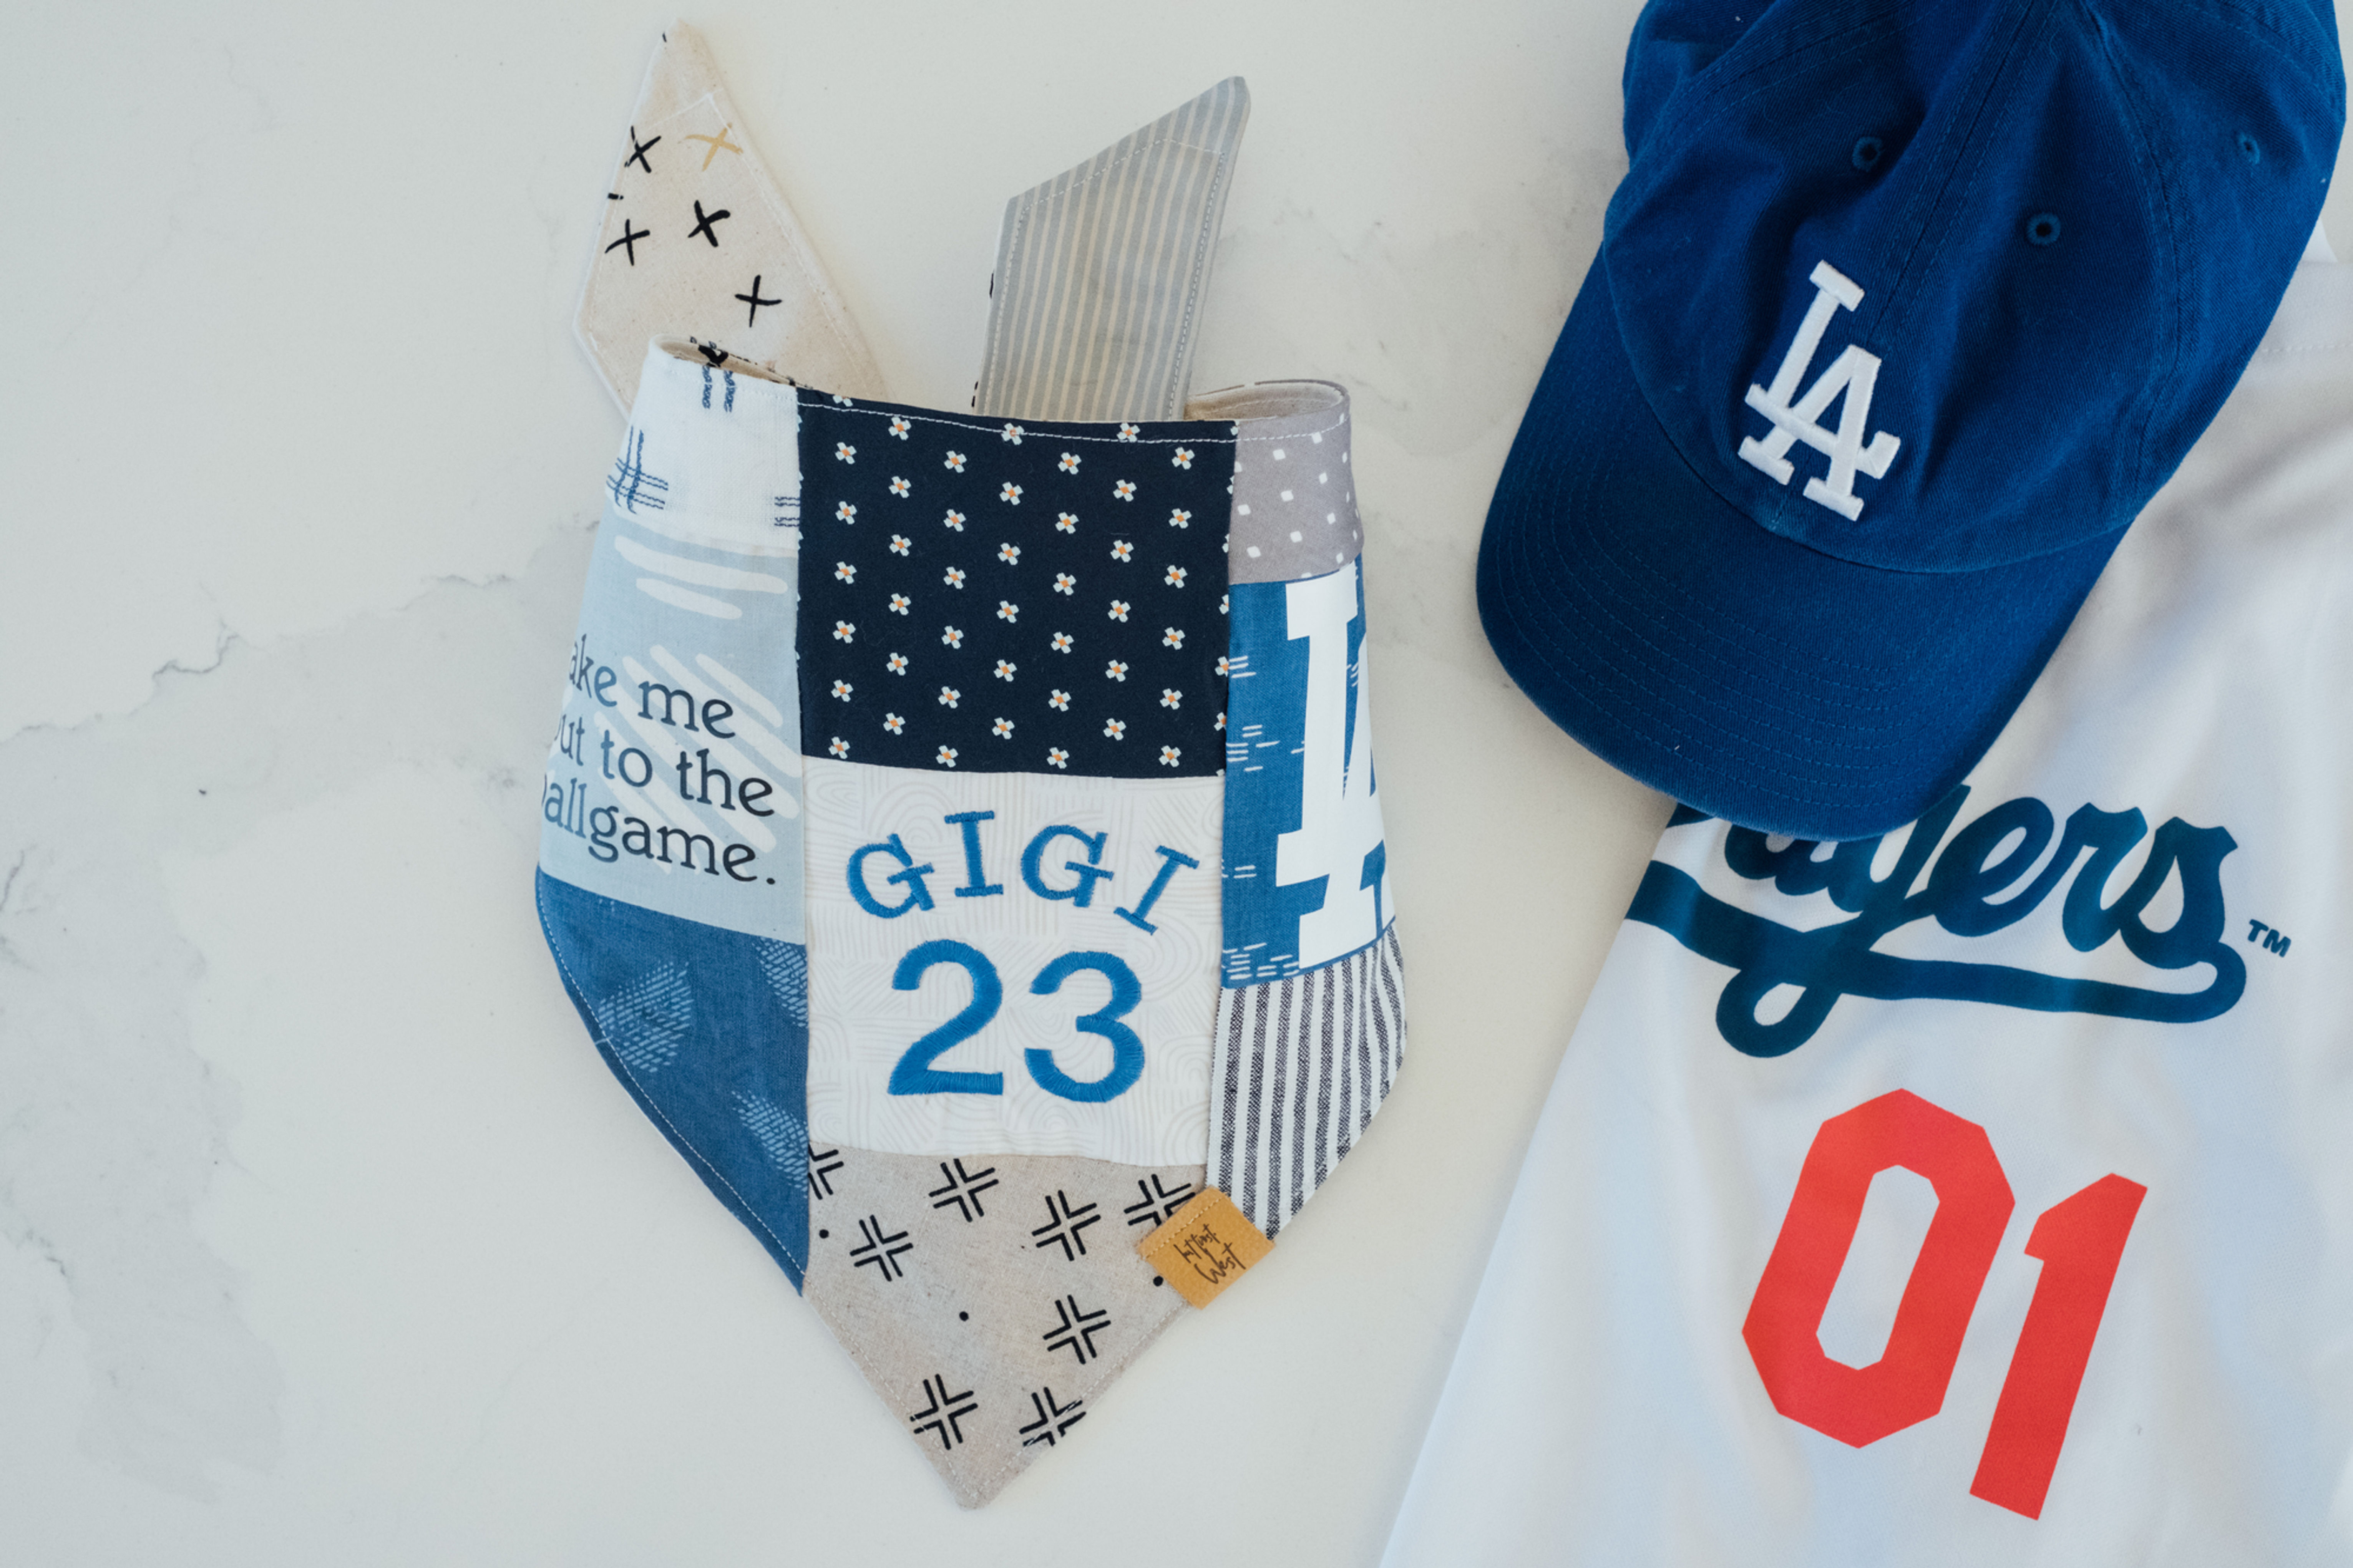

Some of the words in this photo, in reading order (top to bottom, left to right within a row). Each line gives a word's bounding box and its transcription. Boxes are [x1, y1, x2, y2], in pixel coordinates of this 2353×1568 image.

[1738, 260, 1901, 521] LA
[554, 714, 585, 766] ut
[600, 729, 653, 787] to
[675, 748, 775, 817] the
[638, 681, 736, 739] me
[541, 772, 776, 885] allgame.
[846, 810, 1200, 935] GIGI
[1625, 783, 2247, 1057] gers
[887, 939, 1145, 1103] 23
[1741, 1087, 2148, 1521] 01
